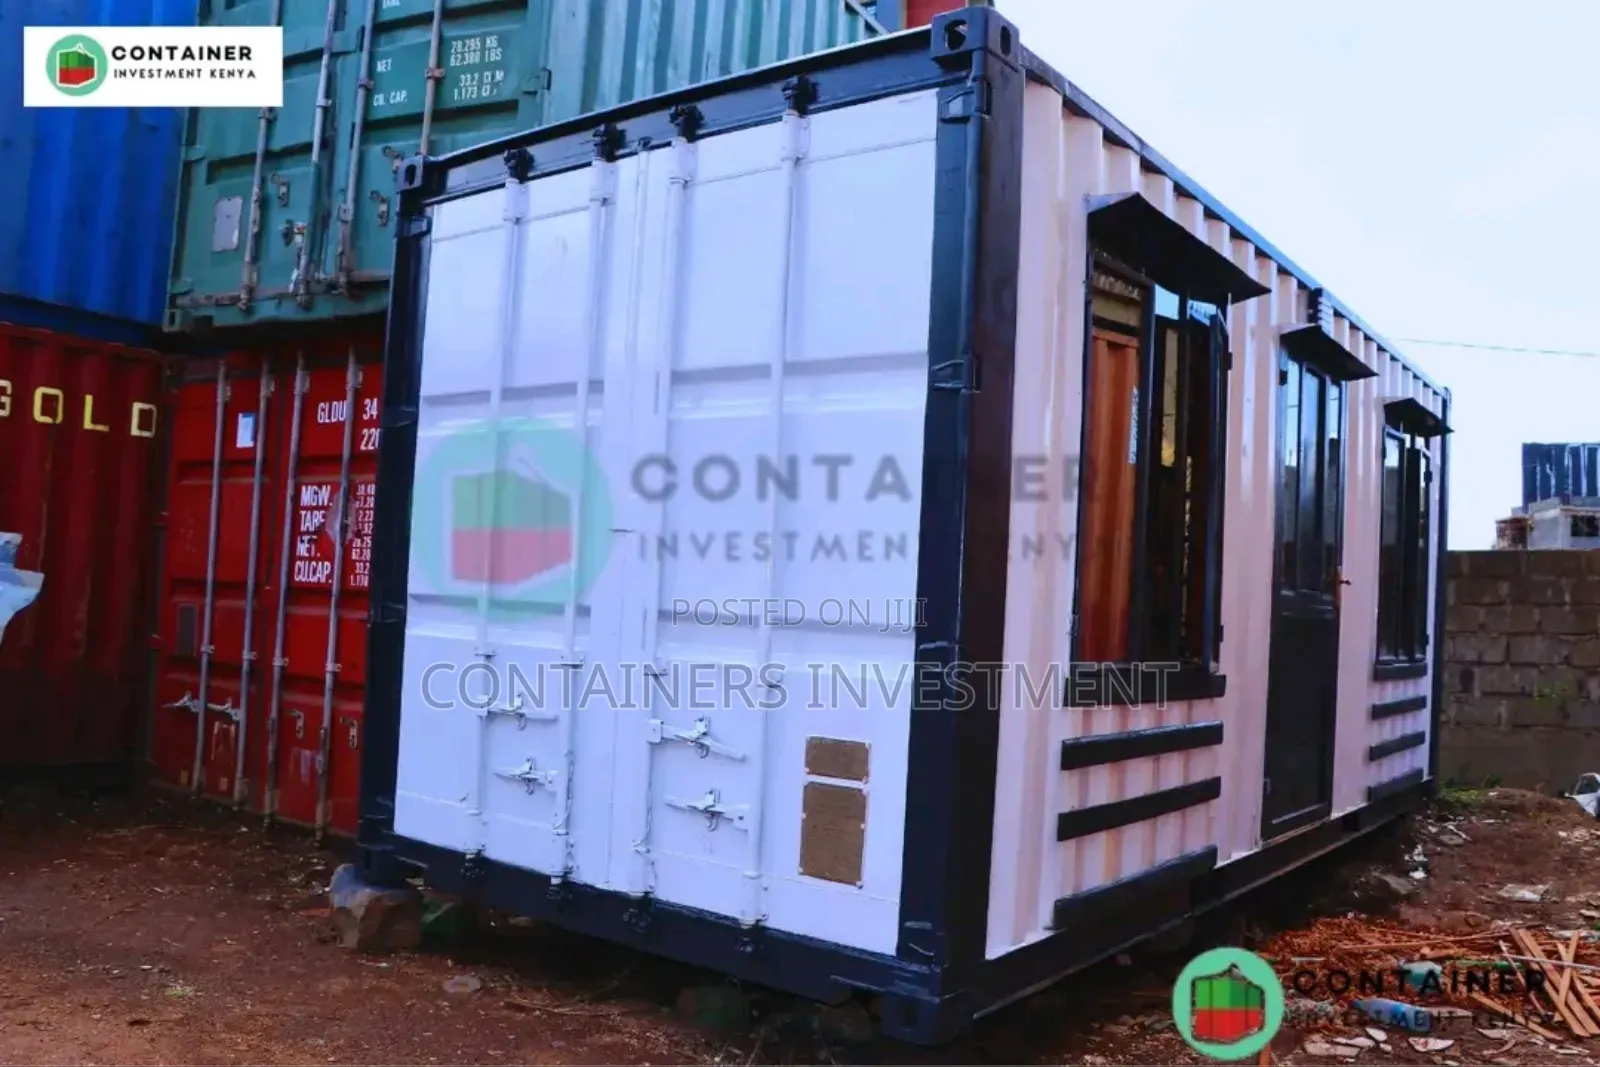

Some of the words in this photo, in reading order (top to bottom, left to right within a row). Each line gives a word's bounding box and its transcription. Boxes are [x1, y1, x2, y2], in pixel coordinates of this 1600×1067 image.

[485, 35, 499, 48] KG
[484, 47, 503, 63] LBS
[376, 58, 392, 73] NET
[459, 72, 479, 87] 33.2
[453, 85, 478, 101] 1.173
[317, 402, 346, 423] GLDU
[300, 484, 333, 507] MGW.
